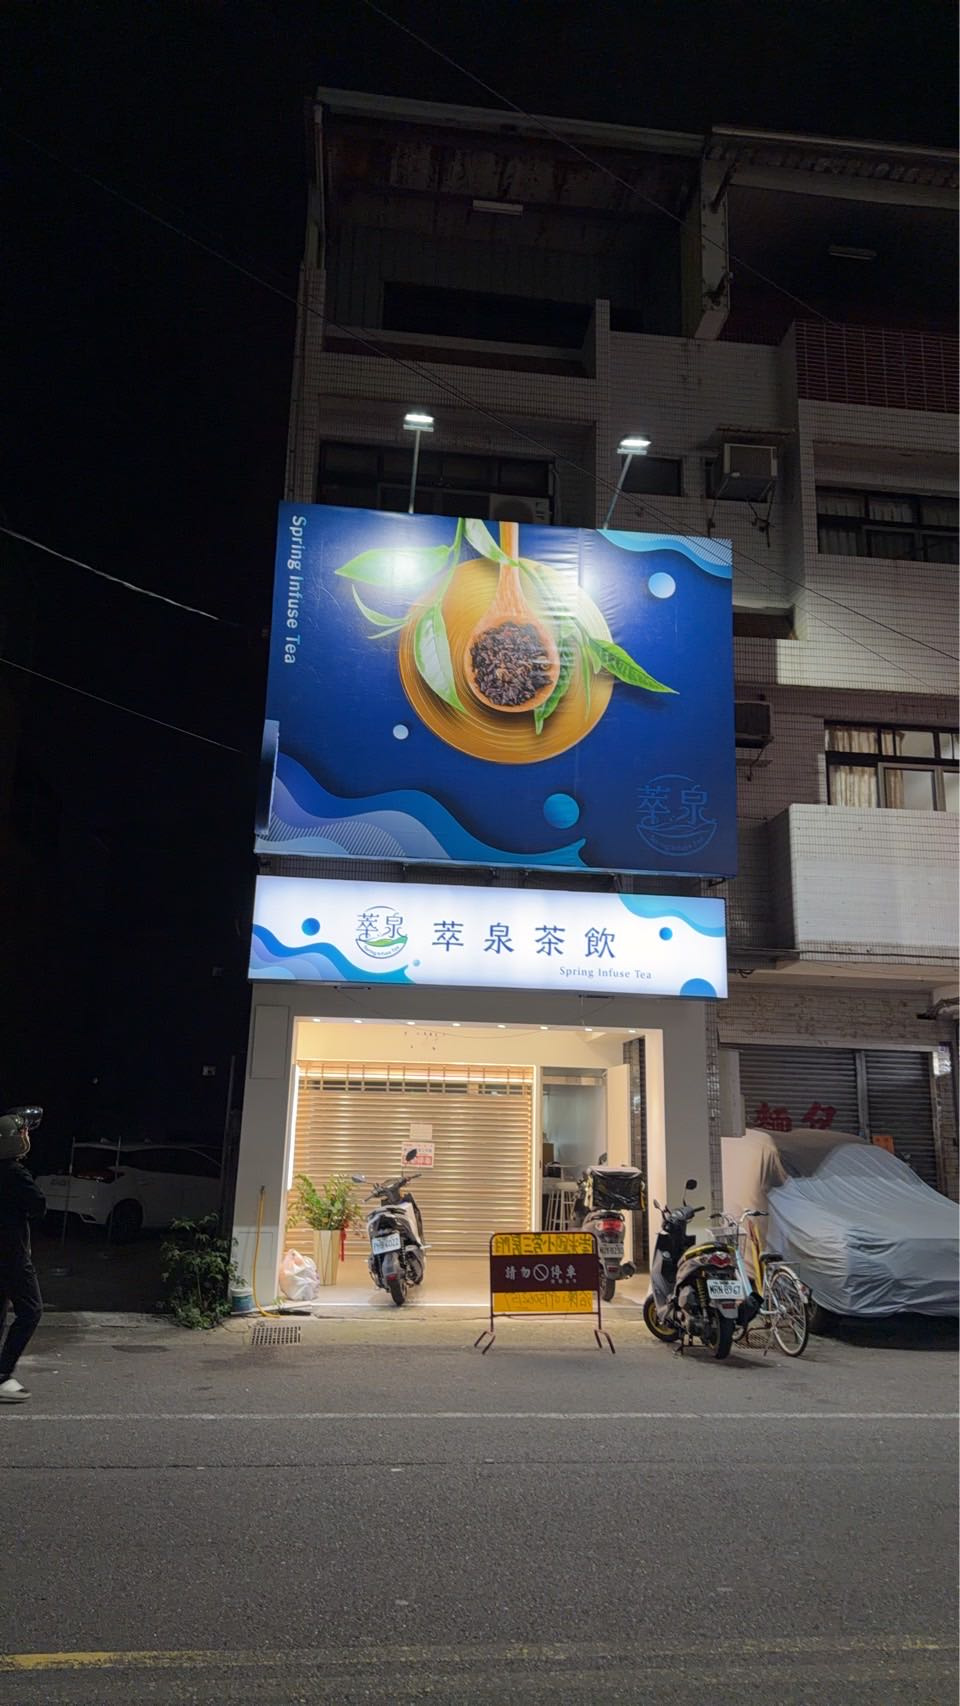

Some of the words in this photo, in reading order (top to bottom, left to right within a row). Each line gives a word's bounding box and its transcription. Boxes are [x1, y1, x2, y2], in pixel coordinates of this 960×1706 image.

[287, 515, 307, 570] Spring
[286, 575, 304, 629] Infuse
[284, 634, 301, 664] Tea
[431, 920, 616, 959] 萃泉茶飲
[559, 966, 594, 979] Spring
[598, 968, 631, 979] Infuse
[634, 969, 653, 980] Tea
[505, 1264, 531, 1281] 請勿
[550, 1264, 577, 1280] 停車
